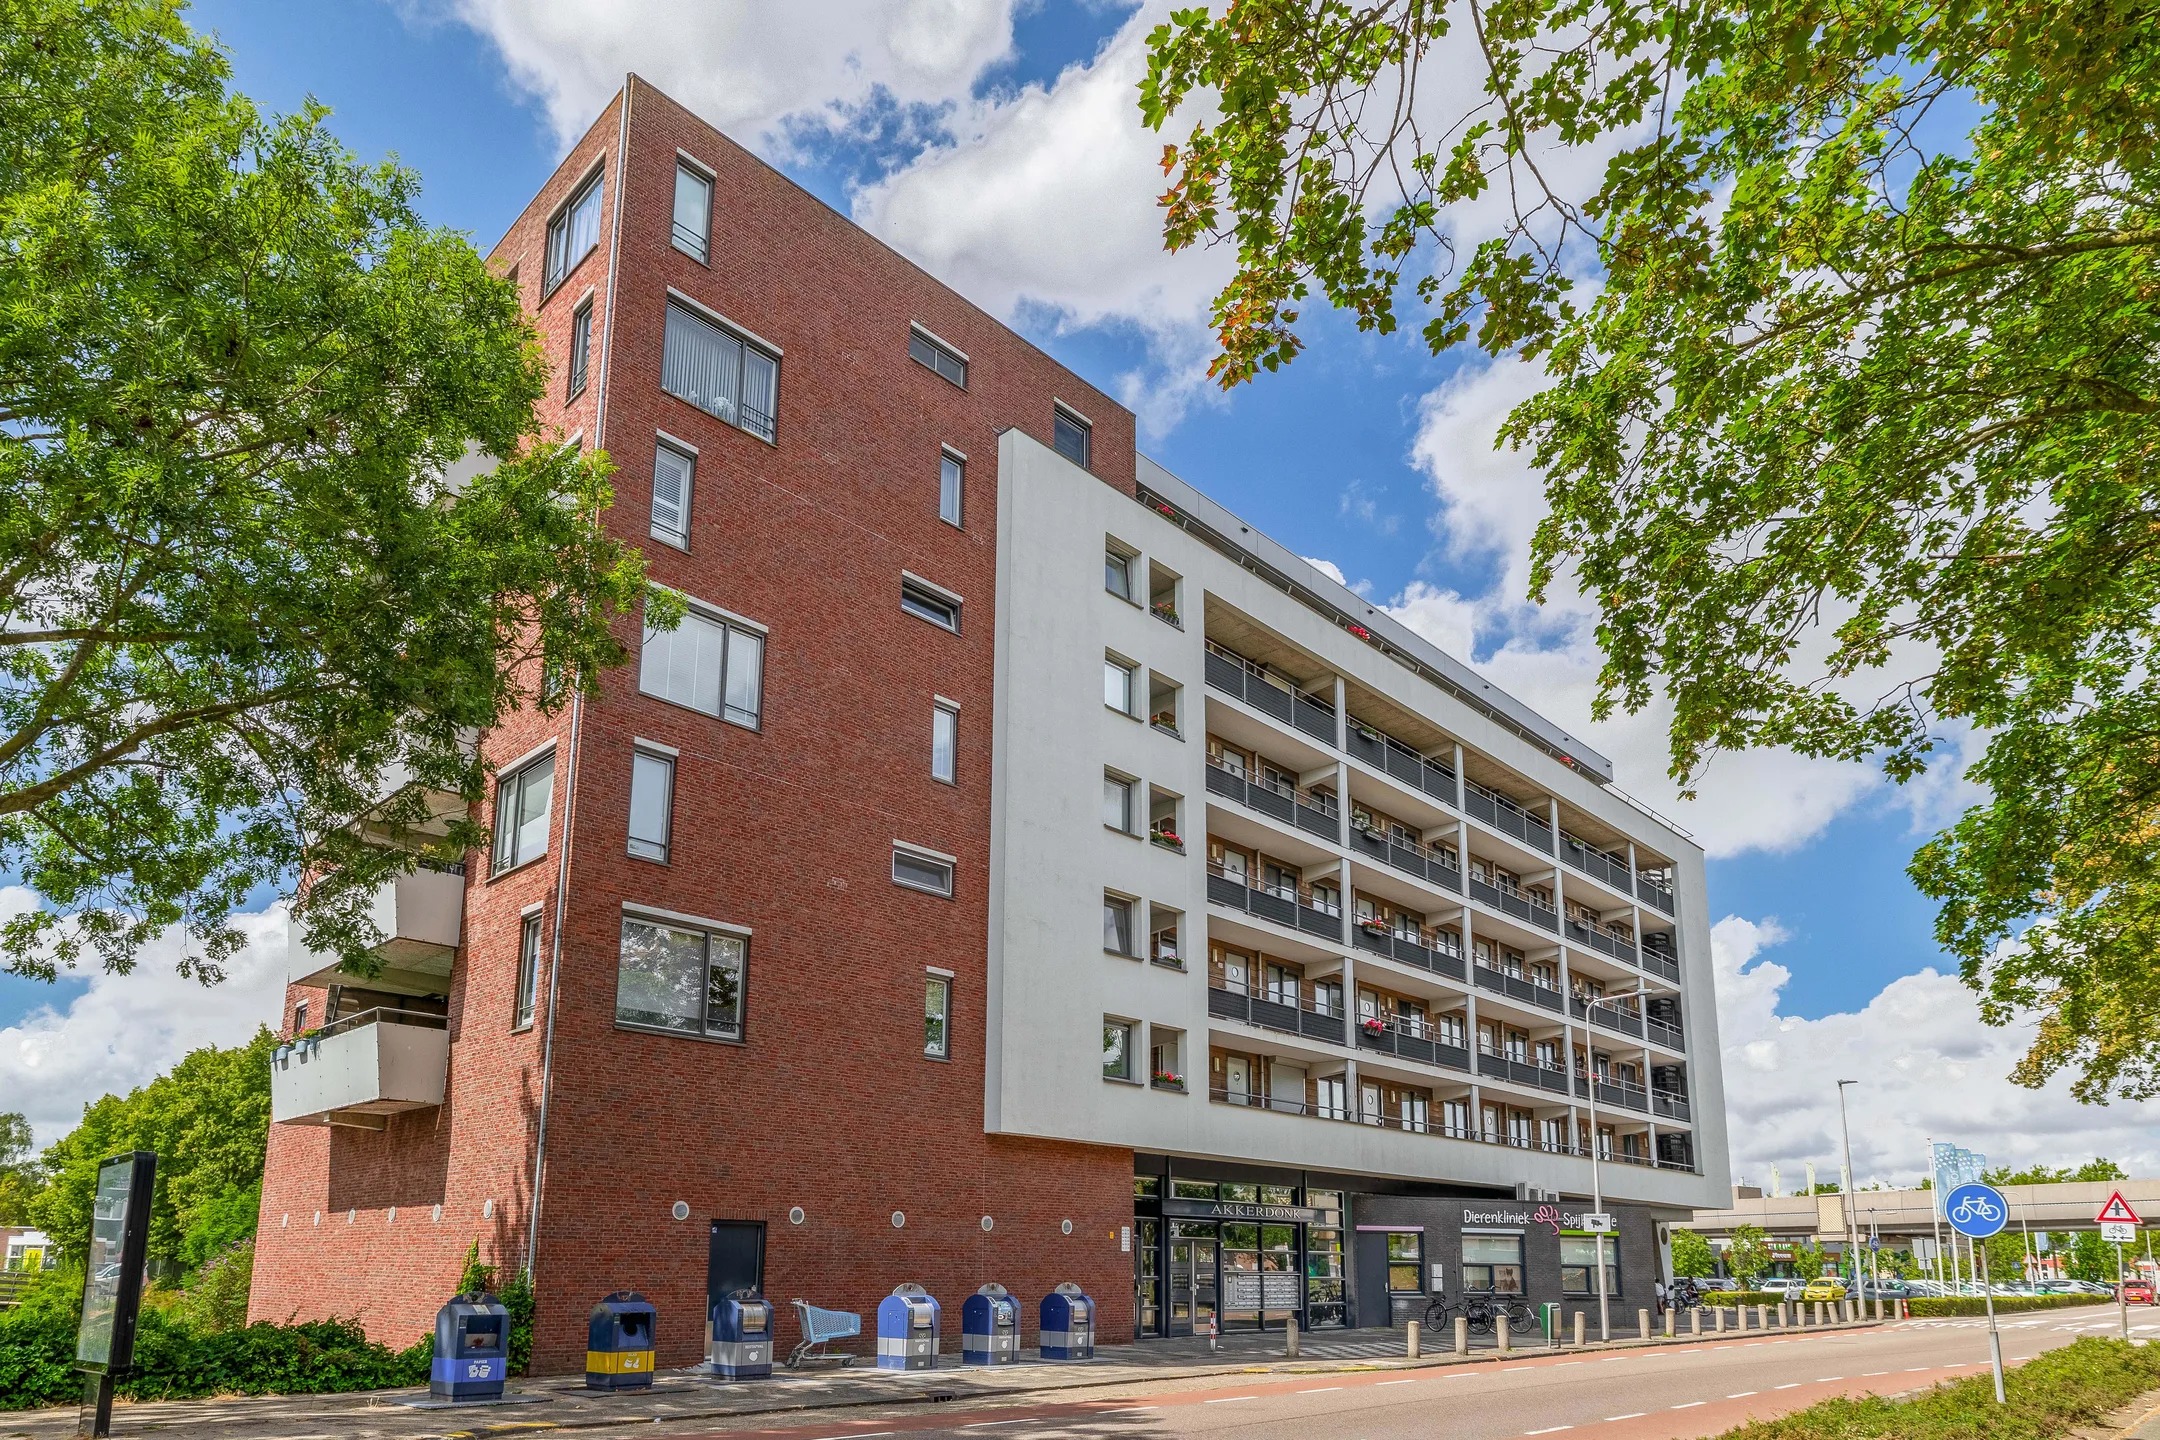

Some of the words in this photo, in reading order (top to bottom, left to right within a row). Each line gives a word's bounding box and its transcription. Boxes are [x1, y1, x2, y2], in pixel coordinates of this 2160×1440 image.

[1211, 1204, 1301, 1219] AKKERDONK
[1464, 1209, 1531, 1225] Dierenkliniek
[1563, 1212, 1617, 1228] Spijke
